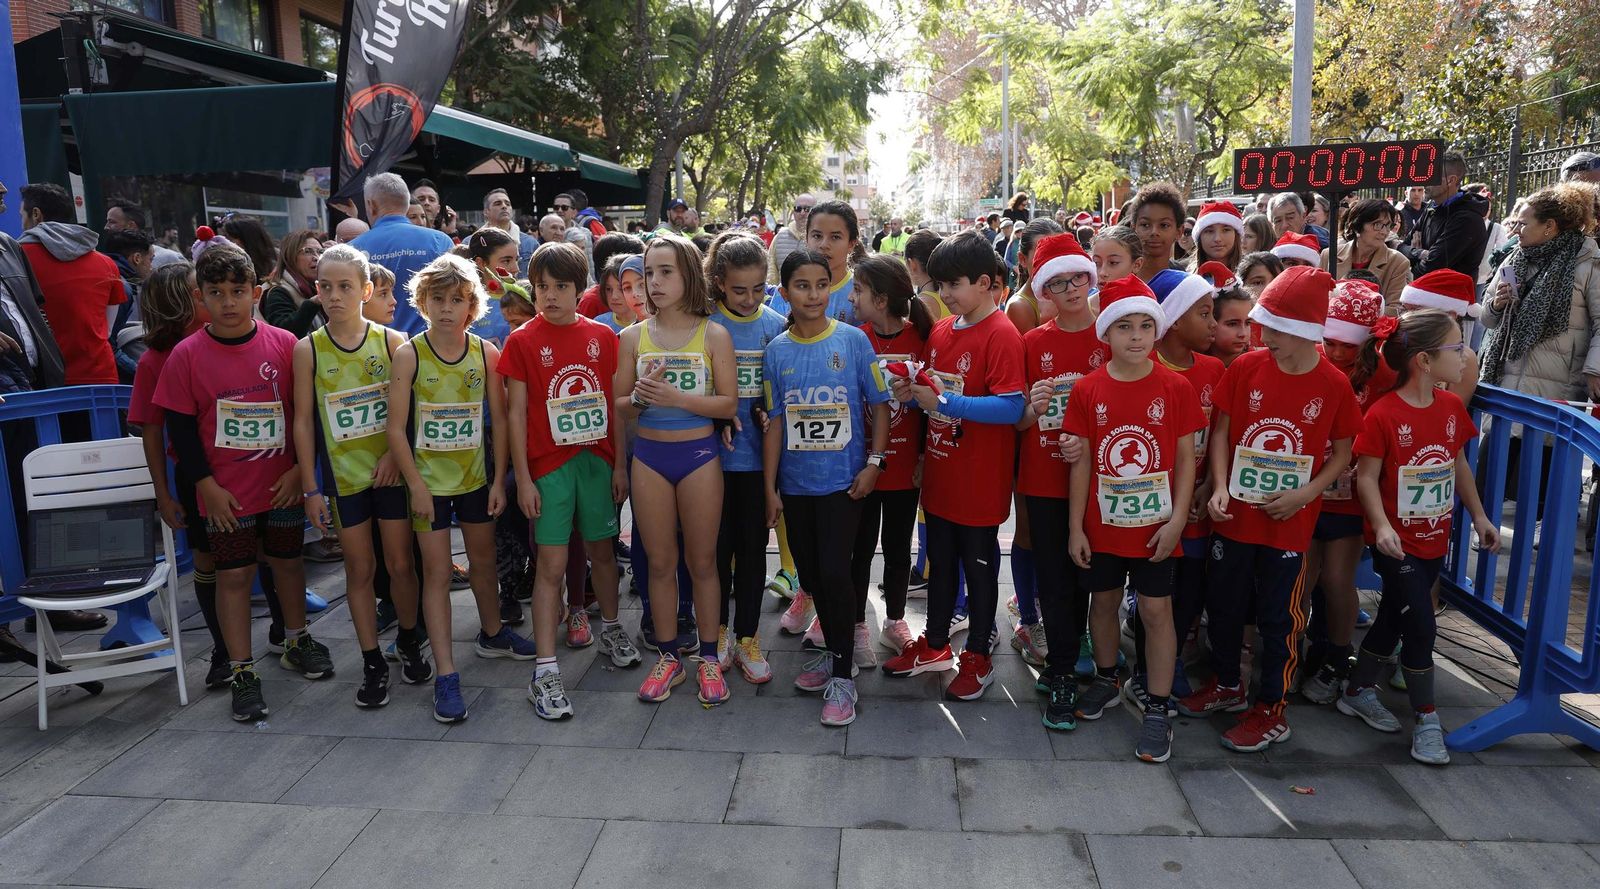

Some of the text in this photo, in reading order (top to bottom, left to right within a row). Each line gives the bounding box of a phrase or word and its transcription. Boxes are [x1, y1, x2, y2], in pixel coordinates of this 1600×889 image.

[361, 0, 404, 65] Tur
[371, 248, 427, 261] dorsalchip.es
[336, 400, 388, 428] 672
[557, 408, 604, 432] 603
[224, 418, 276, 438] 631
[424, 419, 474, 439] 634
[793, 420, 842, 439] 127
[1097, 434, 1112, 465] CARRERA
[1110, 424, 1145, 437] SOLIDARIA
[1144, 430, 1154, 440] DE
[1151, 439, 1161, 469] NAVIDAD
[1239, 467, 1299, 491] 699
[1104, 492, 1162, 515] 734
[1407, 479, 1452, 505] 710
